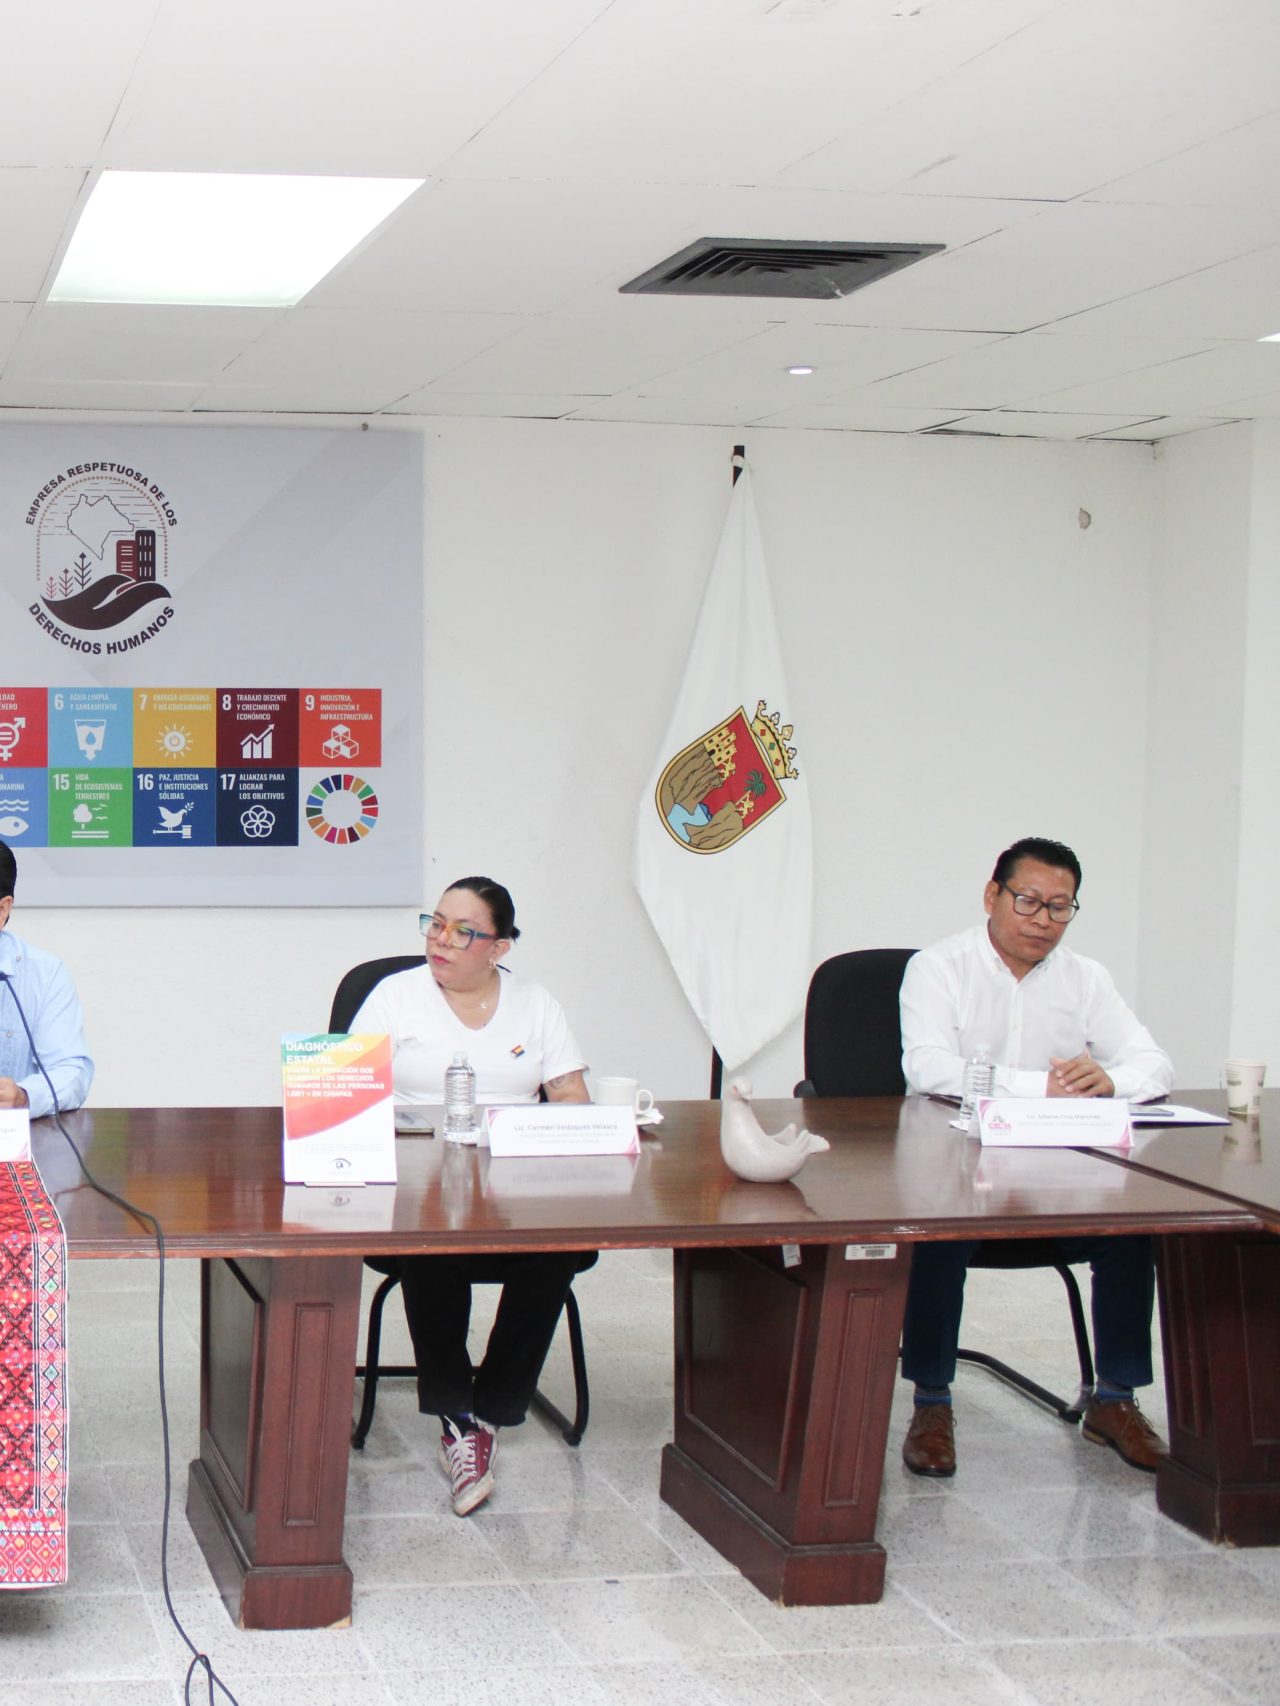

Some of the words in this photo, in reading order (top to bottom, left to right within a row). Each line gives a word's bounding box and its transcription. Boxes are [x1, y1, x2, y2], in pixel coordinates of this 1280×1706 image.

[25, 473, 66, 526] EMPRESA
[66, 461, 149, 487] RESPETUOSA
[149, 484, 165, 502] DE
[161, 501, 178, 527] LOS
[28, 602, 101, 655] DERECHOS
[106, 605, 175, 655] HUMANOS
[54, 694, 64, 711] 6
[139, 694, 147, 711] 7
[222, 694, 232, 711] 8
[237, 694, 262, 702] TRABAJO
[263, 694, 287, 702] DECENTE
[305, 695, 314, 711] 9
[320, 703, 355, 711] INNOVACIÓN
[237, 712, 271, 721] ECONÓMICO
[320, 713, 373, 721] INFRAESTRUCTURA
[53, 774, 69, 791] 15
[137, 774, 154, 791] 16
[159, 774, 171, 782] PAZ,
[220, 774, 236, 791] 17
[75, 783, 83, 791] DE
[84, 783, 123, 791] ECOSISTEMAS
[159, 783, 163, 791] E
[164, 783, 208, 791] INSTITUCIONES
[239, 783, 263, 791] LOGRAR
[159, 791, 184, 800] SÓLIDAS
[239, 792, 253, 800] LOS
[255, 792, 285, 800] OBJETIVOS
[286, 1041, 362, 1052] DIAGNÓSTICO
